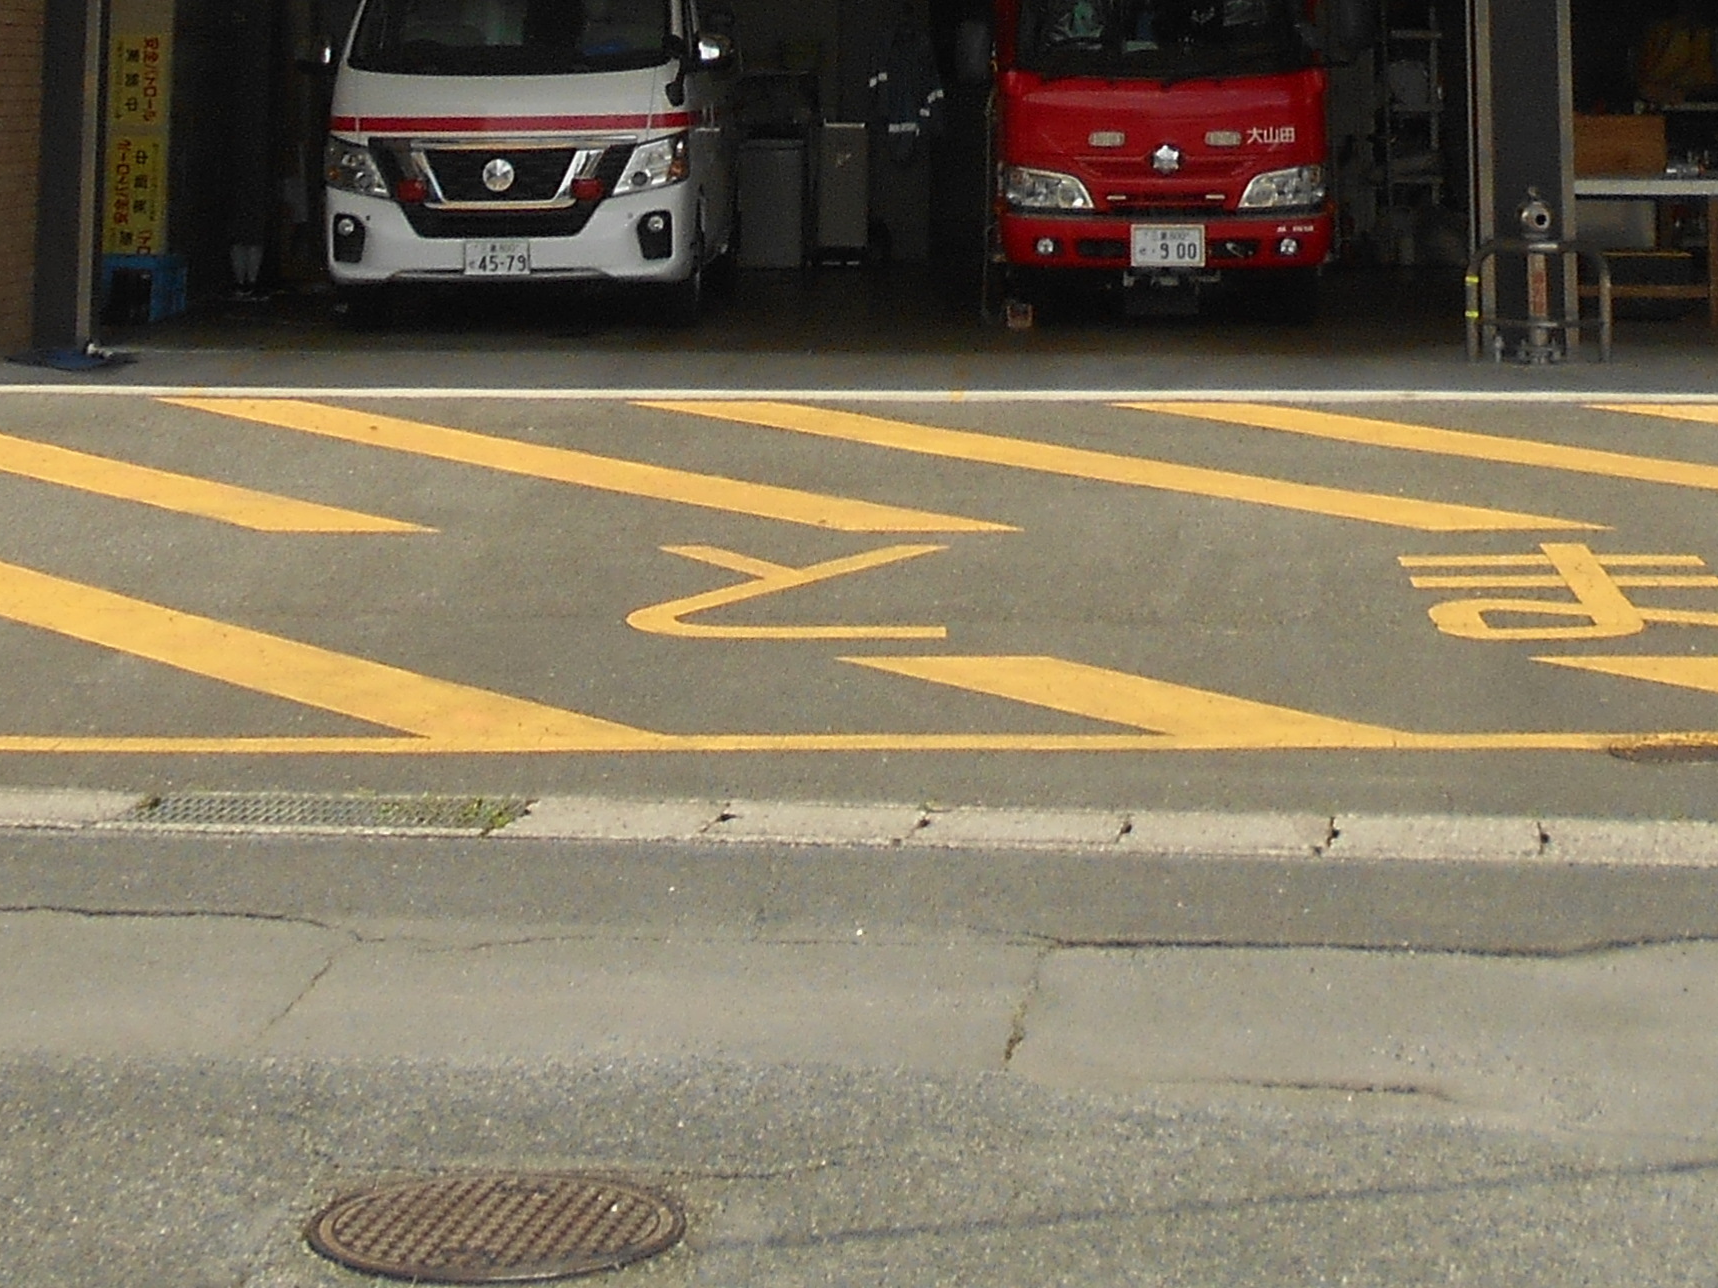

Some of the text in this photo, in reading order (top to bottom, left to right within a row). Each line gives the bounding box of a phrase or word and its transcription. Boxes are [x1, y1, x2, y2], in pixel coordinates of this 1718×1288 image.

[1246, 126, 1295, 144] 大山田
[478, 255, 526, 272] 45-79
